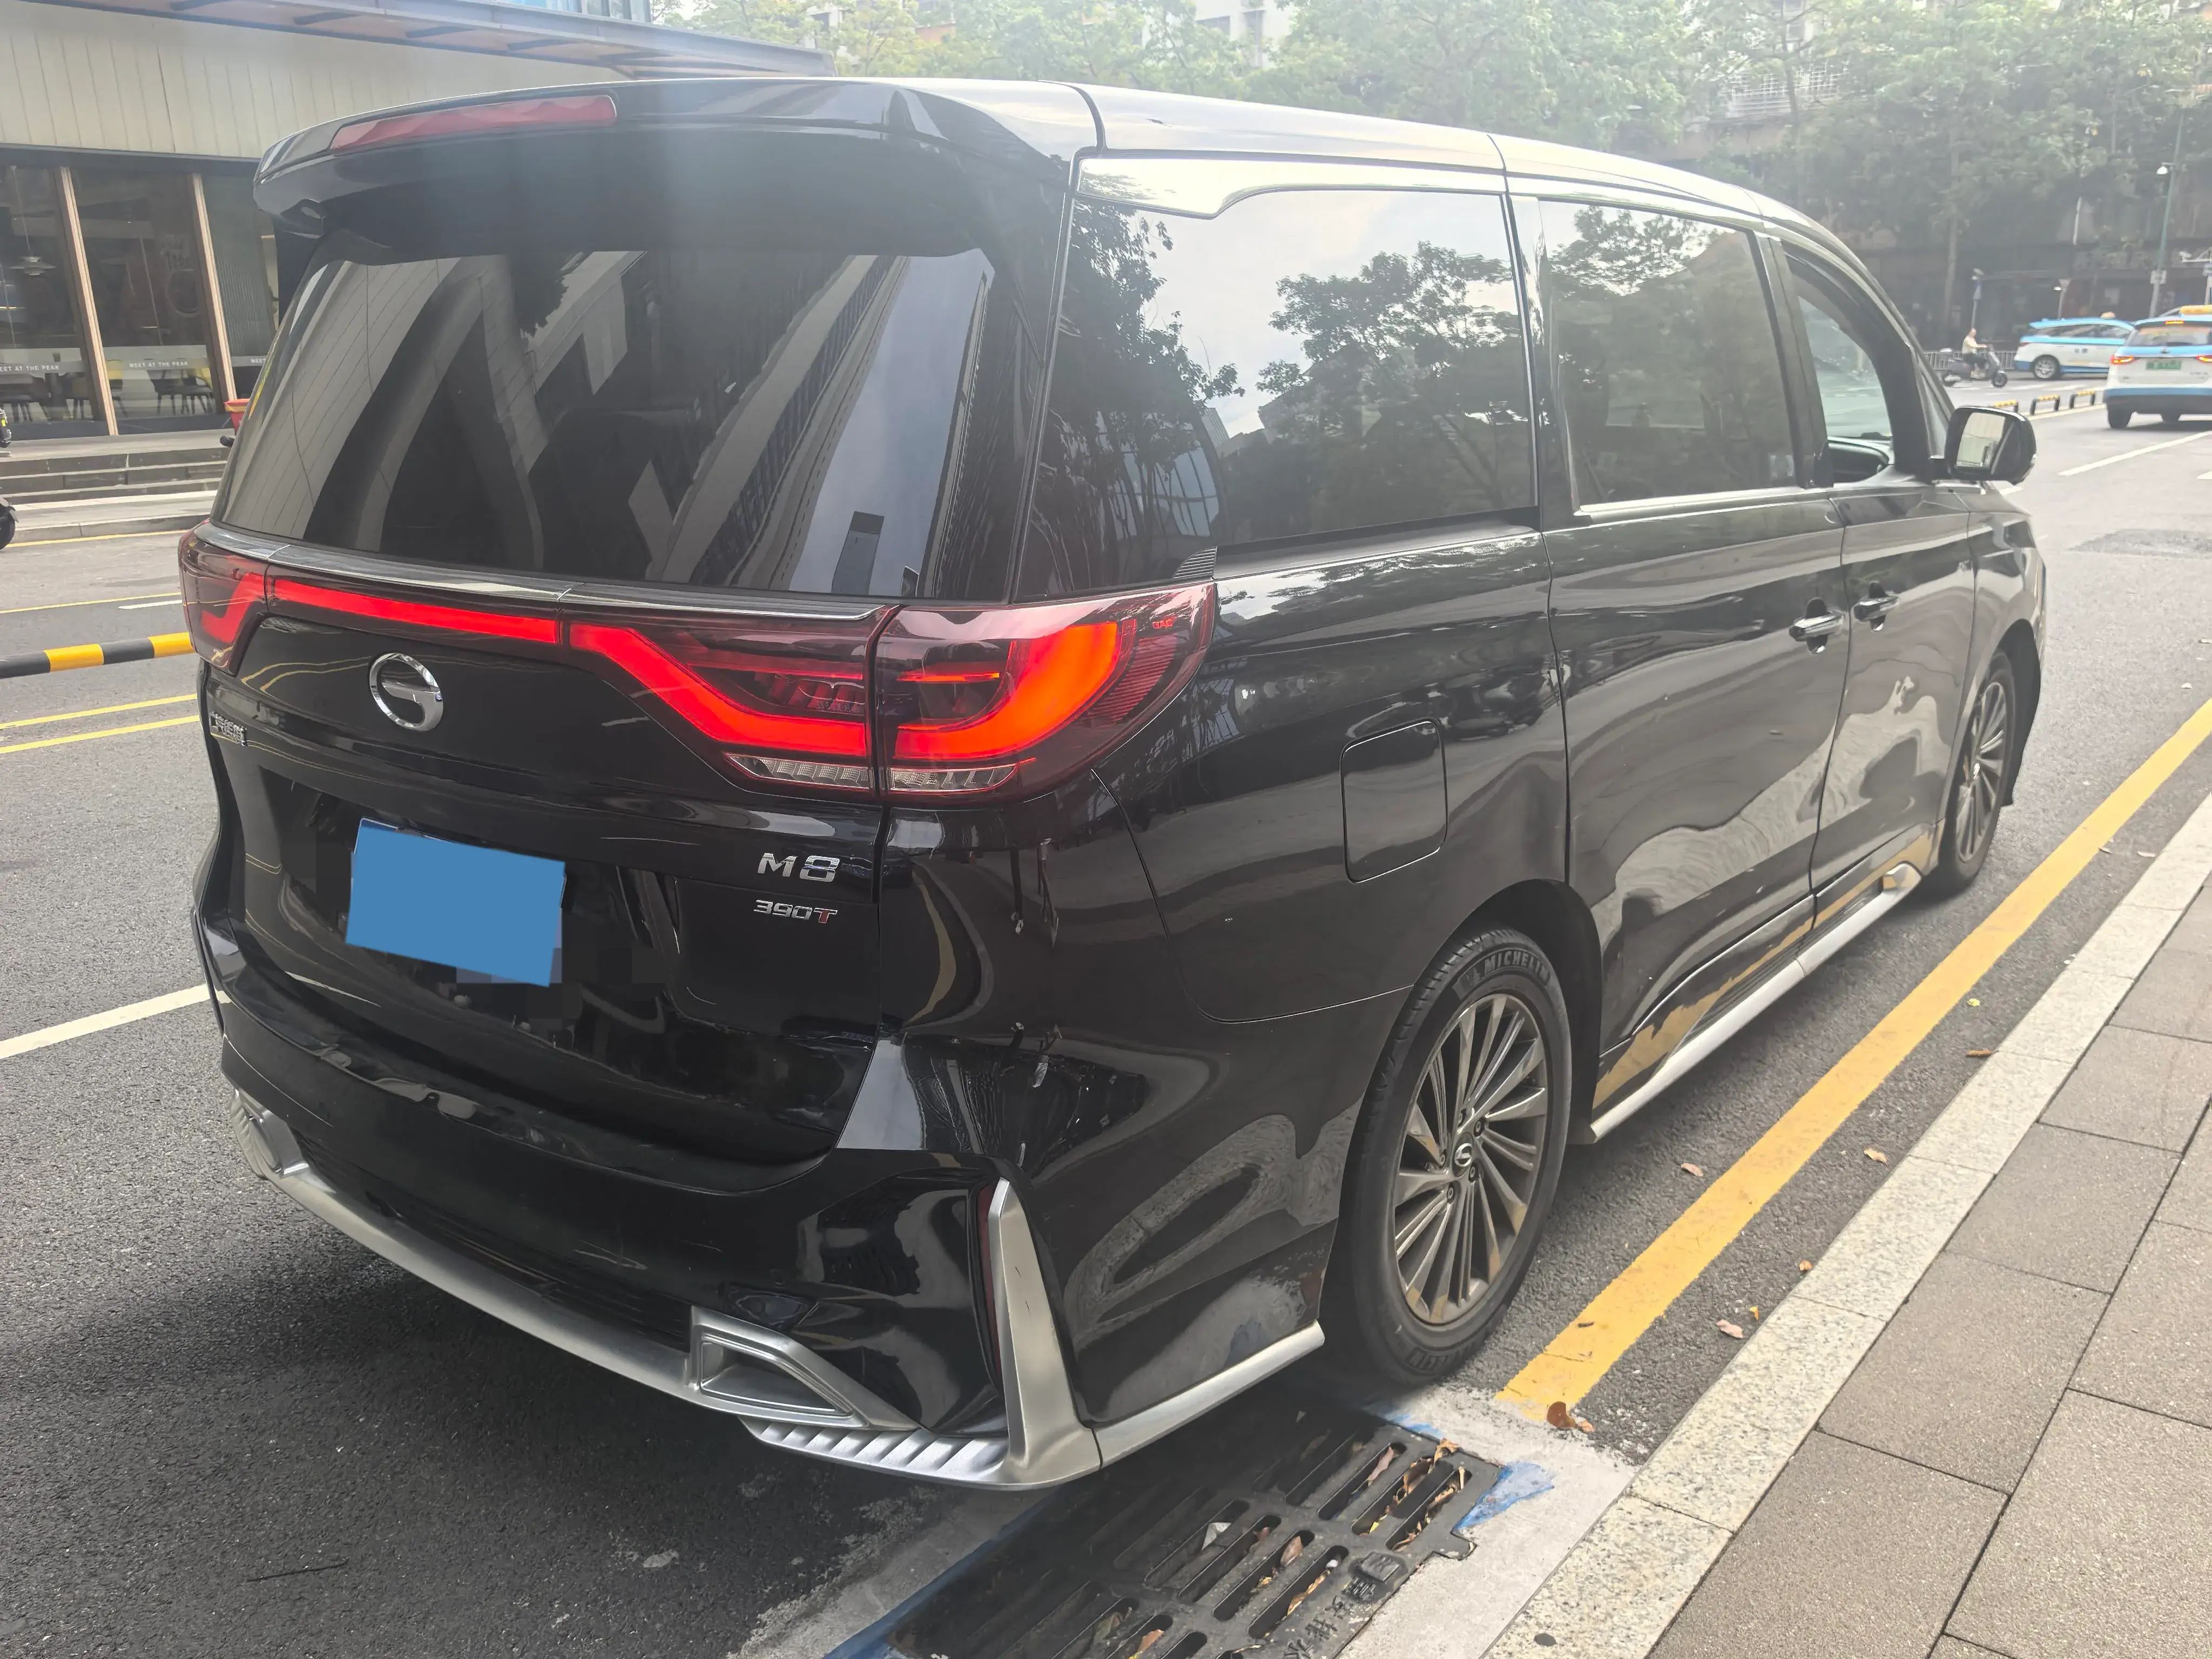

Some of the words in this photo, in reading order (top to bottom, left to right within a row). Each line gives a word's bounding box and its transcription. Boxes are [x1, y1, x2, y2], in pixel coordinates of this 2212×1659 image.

[757, 853, 840, 882] M8
[753, 899, 838, 924] 390T
[1484, 950, 1549, 982] MICHELIN
